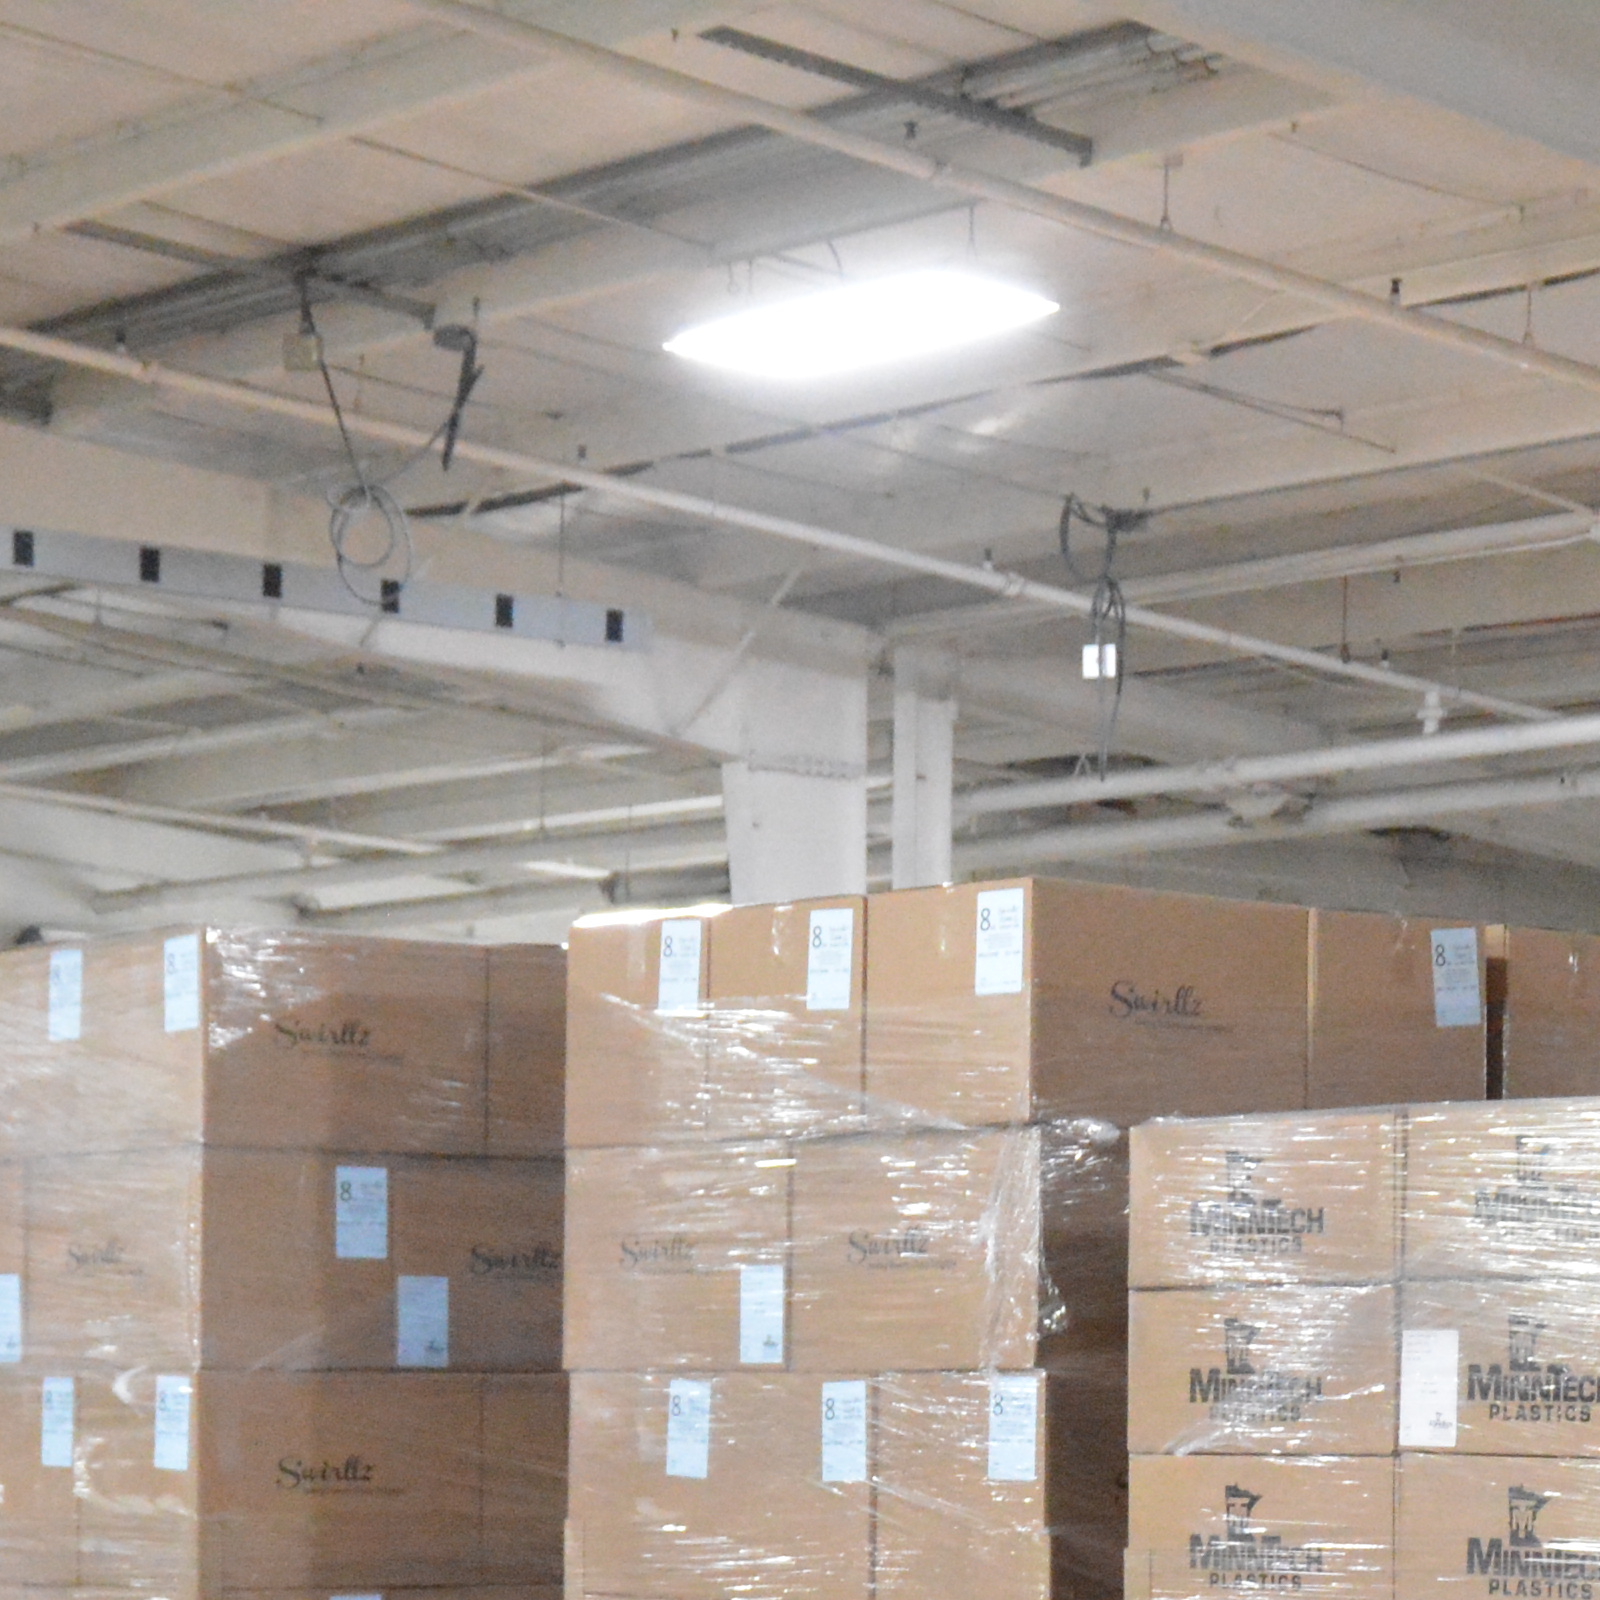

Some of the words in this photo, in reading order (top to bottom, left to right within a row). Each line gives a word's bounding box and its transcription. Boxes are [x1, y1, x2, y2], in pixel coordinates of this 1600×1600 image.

[980, 908, 991, 931] 8
[663, 936, 673, 958] 8
[812, 926, 822, 948] 8
[1435, 944, 1446, 967] 8
[340, 1181, 351, 1201] 8
[825, 1398, 835, 1421] 8
[1489, 1403, 1591, 1423] PLASTICS
[1489, 1578, 1593, 1600] PLASTICS
